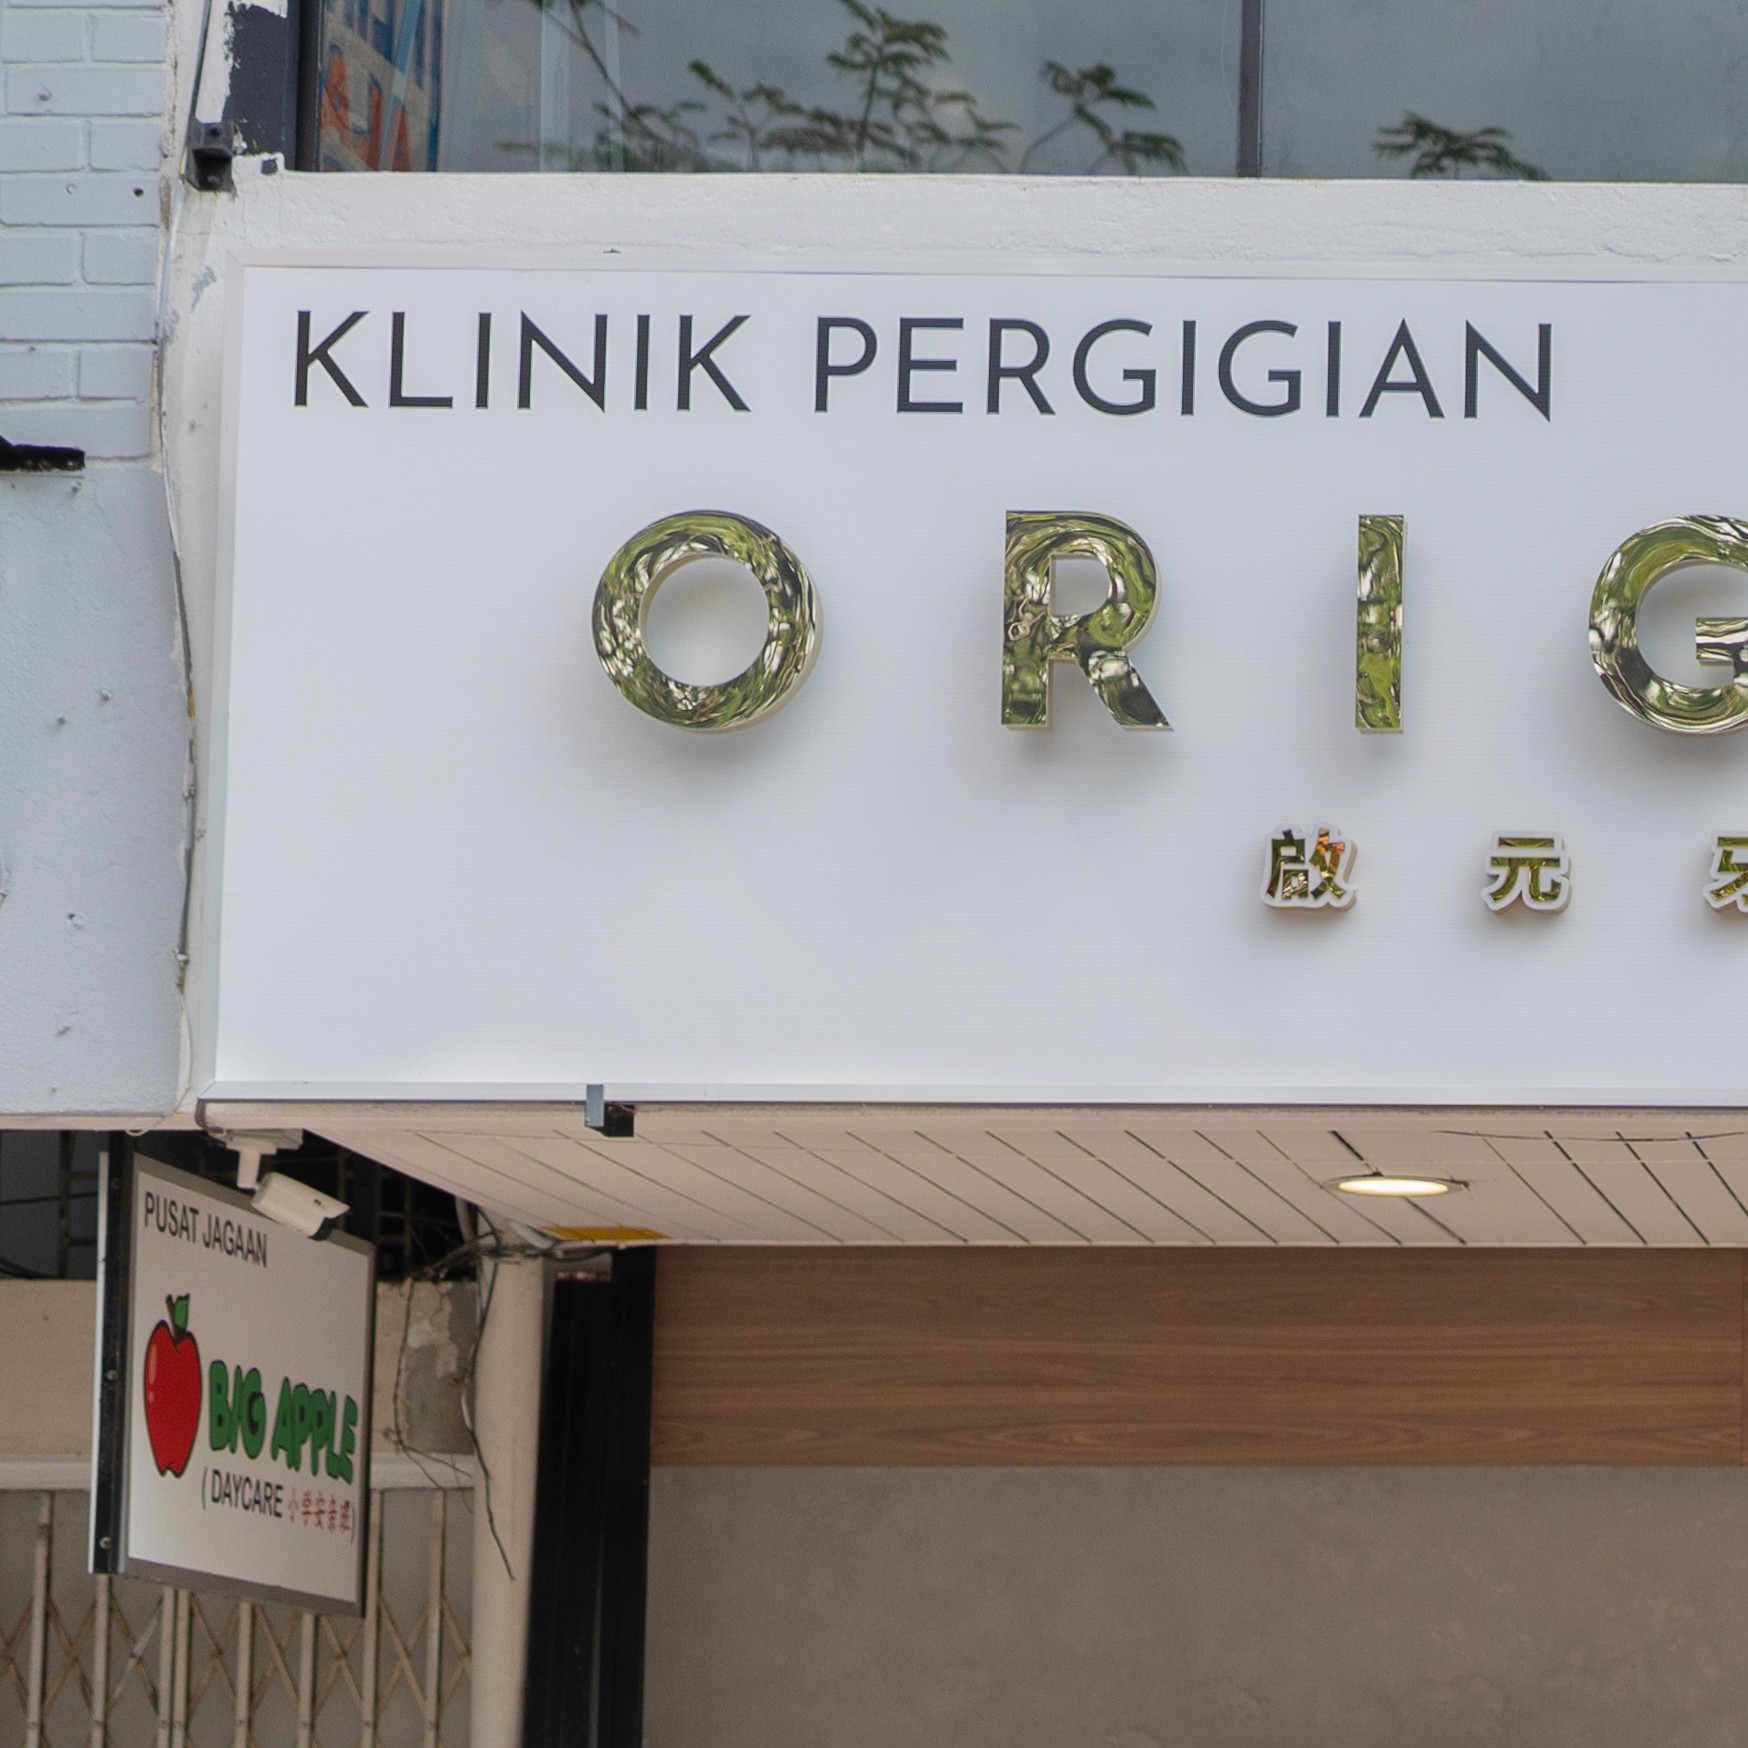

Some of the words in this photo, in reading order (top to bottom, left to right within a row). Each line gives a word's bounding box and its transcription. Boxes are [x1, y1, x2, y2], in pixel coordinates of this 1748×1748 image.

[293, 309, 752, 413] KLINIK
[813, 315, 1555, 423] PERGIGIAN
[144, 1190, 199, 1244] PUSAT
[202, 1213, 268, 1268] JAGAAN
[208, 1359, 267, 1460] BIG
[270, 1375, 358, 1485] APPLE
